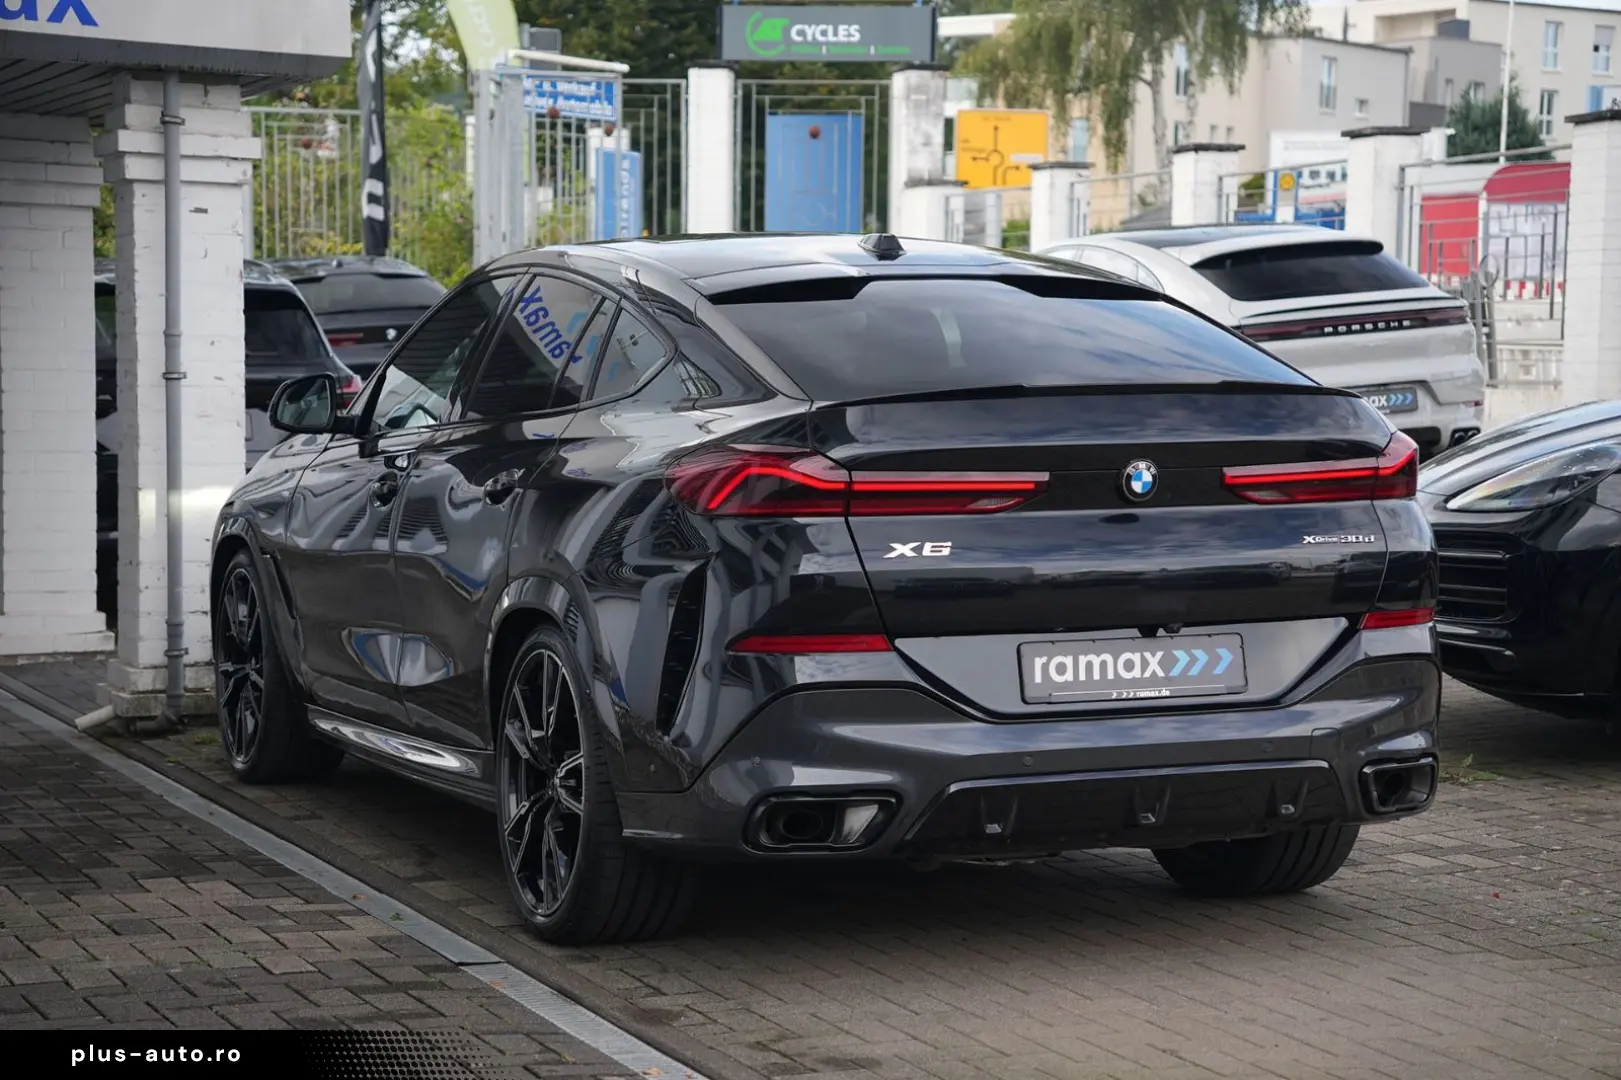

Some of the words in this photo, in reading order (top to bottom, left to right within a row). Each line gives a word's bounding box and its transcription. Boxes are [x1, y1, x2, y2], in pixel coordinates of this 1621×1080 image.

[790, 24, 861, 42] CYCLES
[1323, 319, 1411, 334] PORSCHE
[1128, 462, 1157, 476] BMW
[882, 541, 953, 559] X6
[1033, 650, 1166, 684] ramax
[1136, 688, 1171, 698] ramax.de
